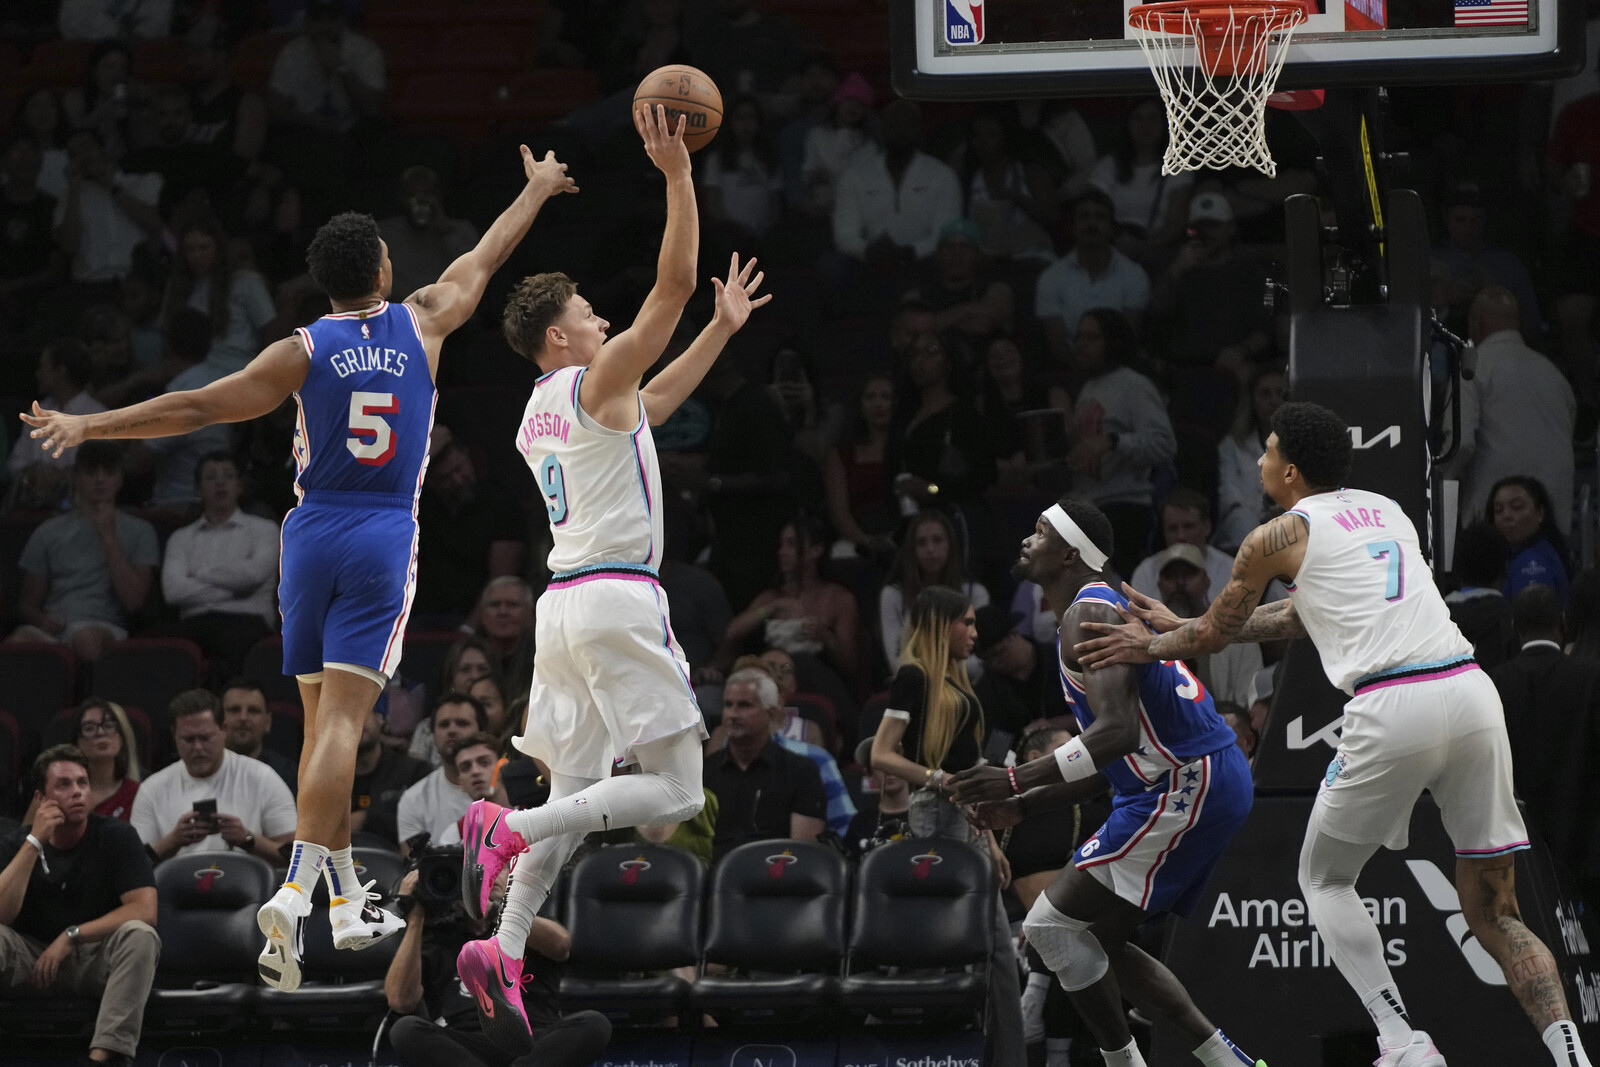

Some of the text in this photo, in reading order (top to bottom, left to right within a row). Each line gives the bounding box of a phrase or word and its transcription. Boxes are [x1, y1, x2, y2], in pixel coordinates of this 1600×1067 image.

[951, 25, 970, 39] NBA
[330, 346, 409, 379] GRIMES
[346, 391, 399, 467] 5
[518, 411, 571, 456] LARSSON
[540, 453, 570, 527] 9
[1332, 507, 1386, 533] WARE
[1366, 540, 1405, 603] 7
[1208, 892, 1407, 928] Amean
[1248, 929, 1407, 968] Airls
